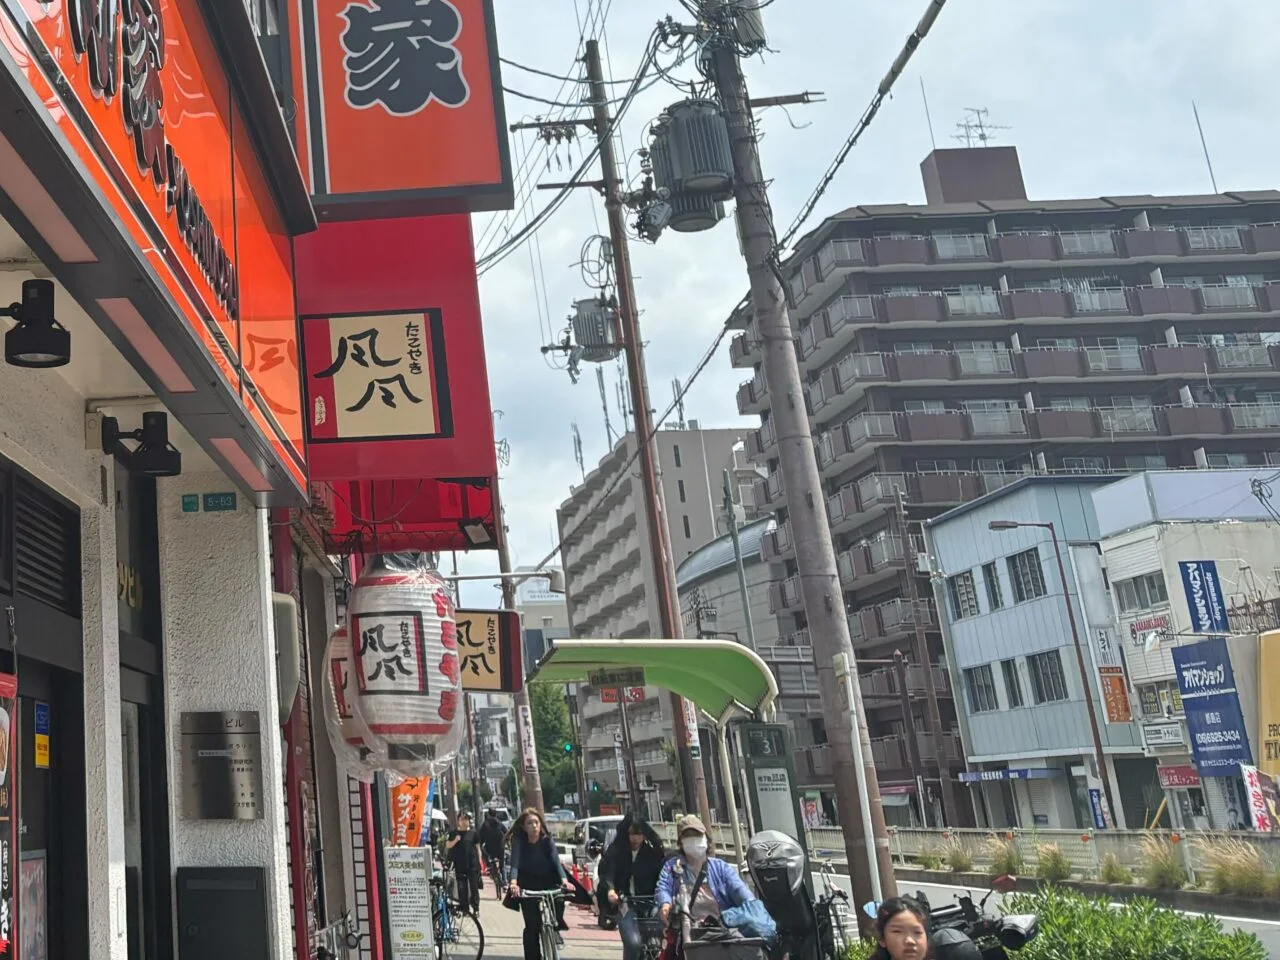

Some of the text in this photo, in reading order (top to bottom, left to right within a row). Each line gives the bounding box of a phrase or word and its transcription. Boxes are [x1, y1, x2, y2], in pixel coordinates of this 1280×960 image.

[405, 320, 422, 375] たこやき
[1265, 741, 1280, 761] TI
